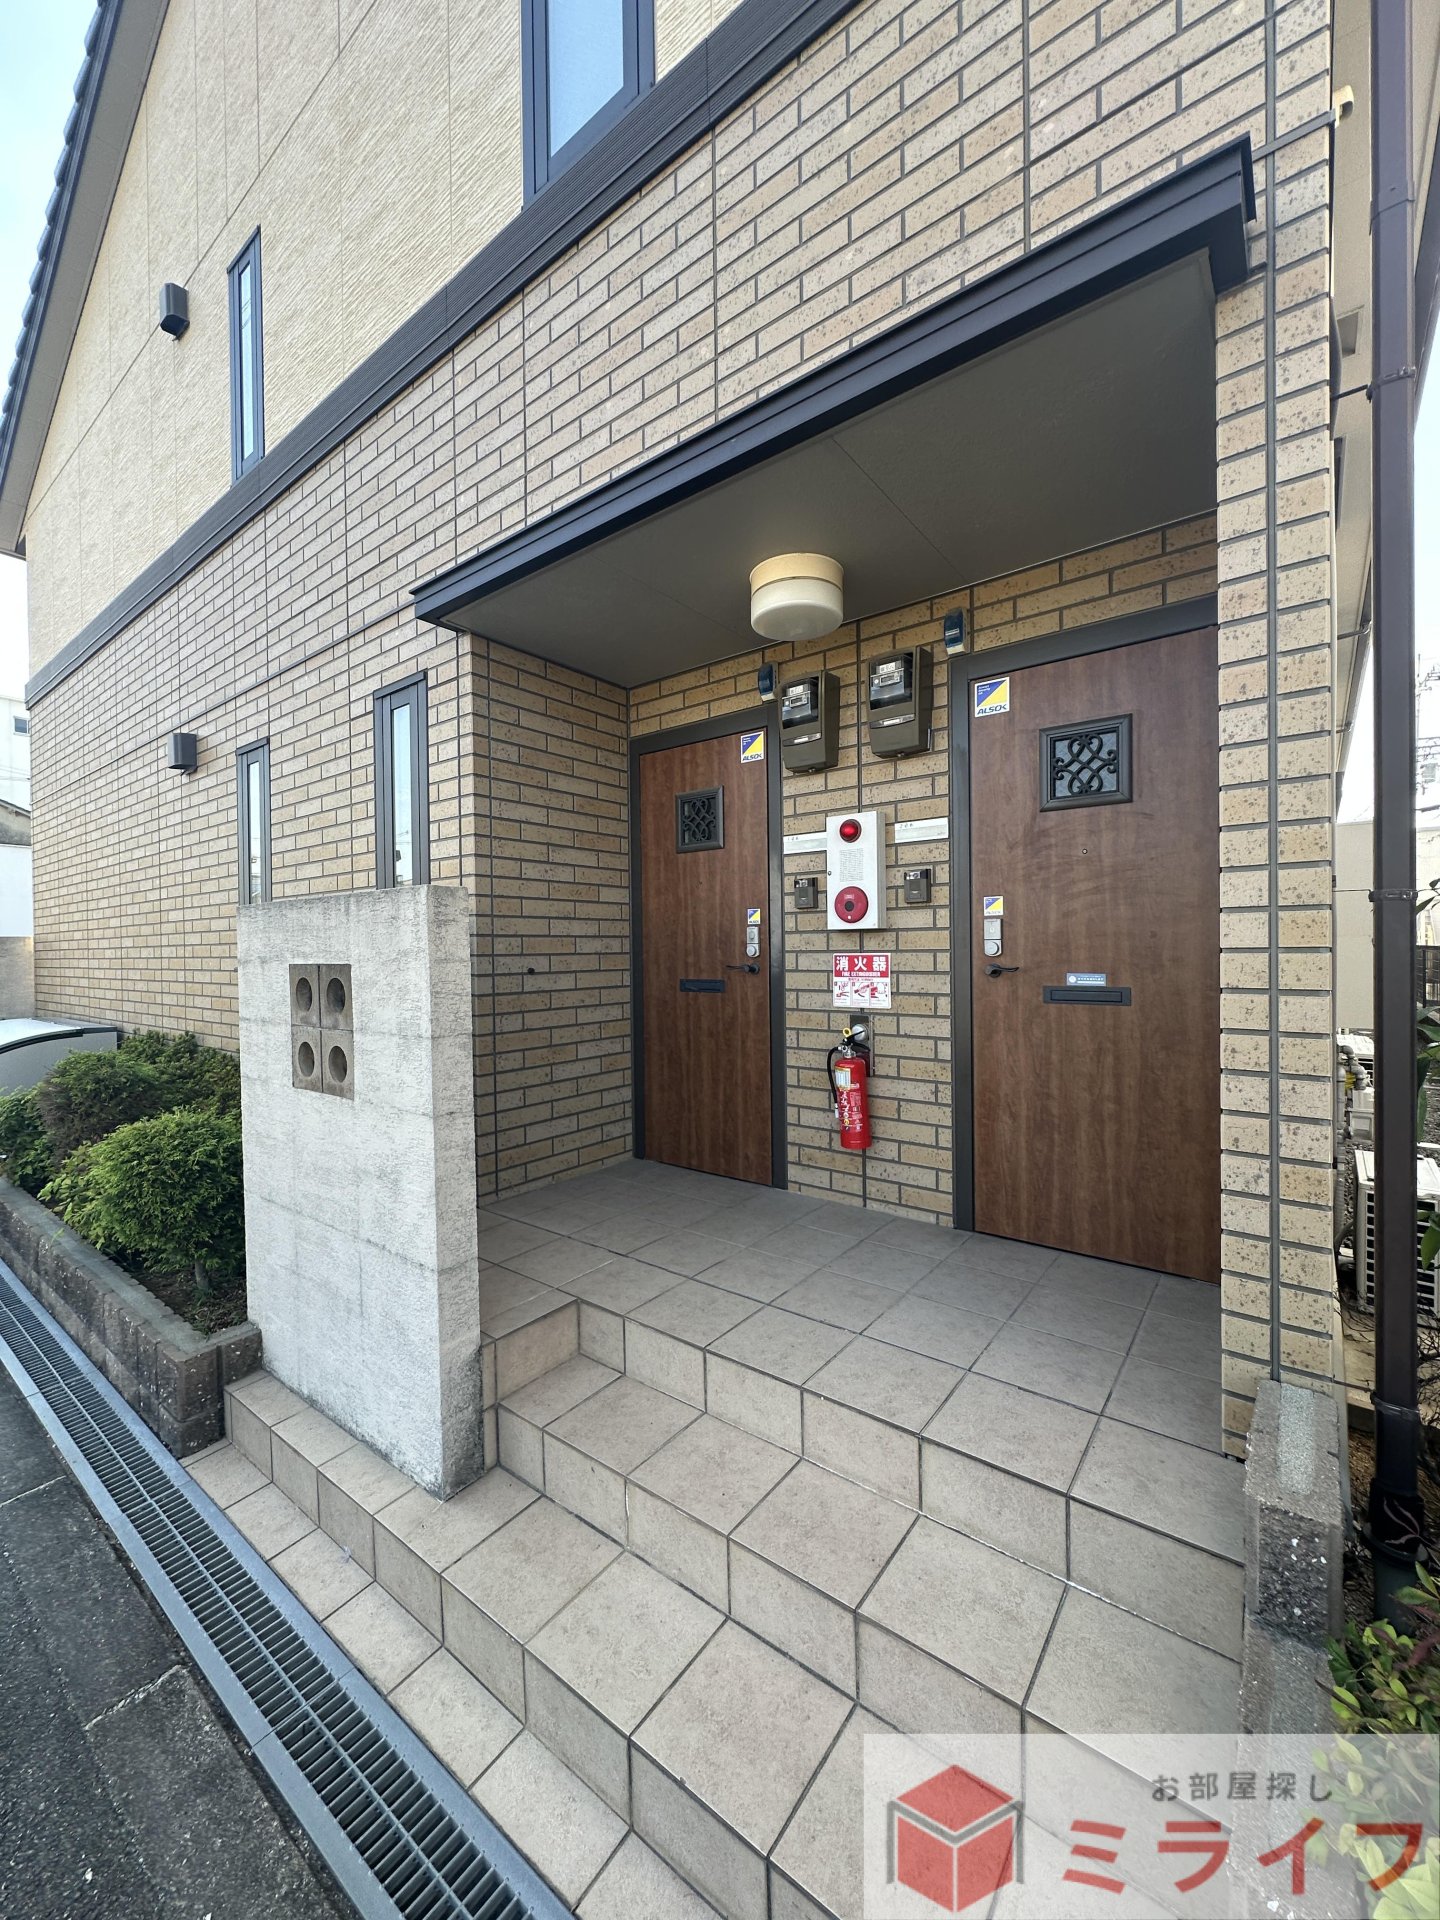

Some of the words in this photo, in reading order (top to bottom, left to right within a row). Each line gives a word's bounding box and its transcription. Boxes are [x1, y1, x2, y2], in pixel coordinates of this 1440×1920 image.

[977, 704, 1007, 715] ALSOK
[742, 753, 763, 761] ALSOK
[836, 956, 887, 972] 消火器
